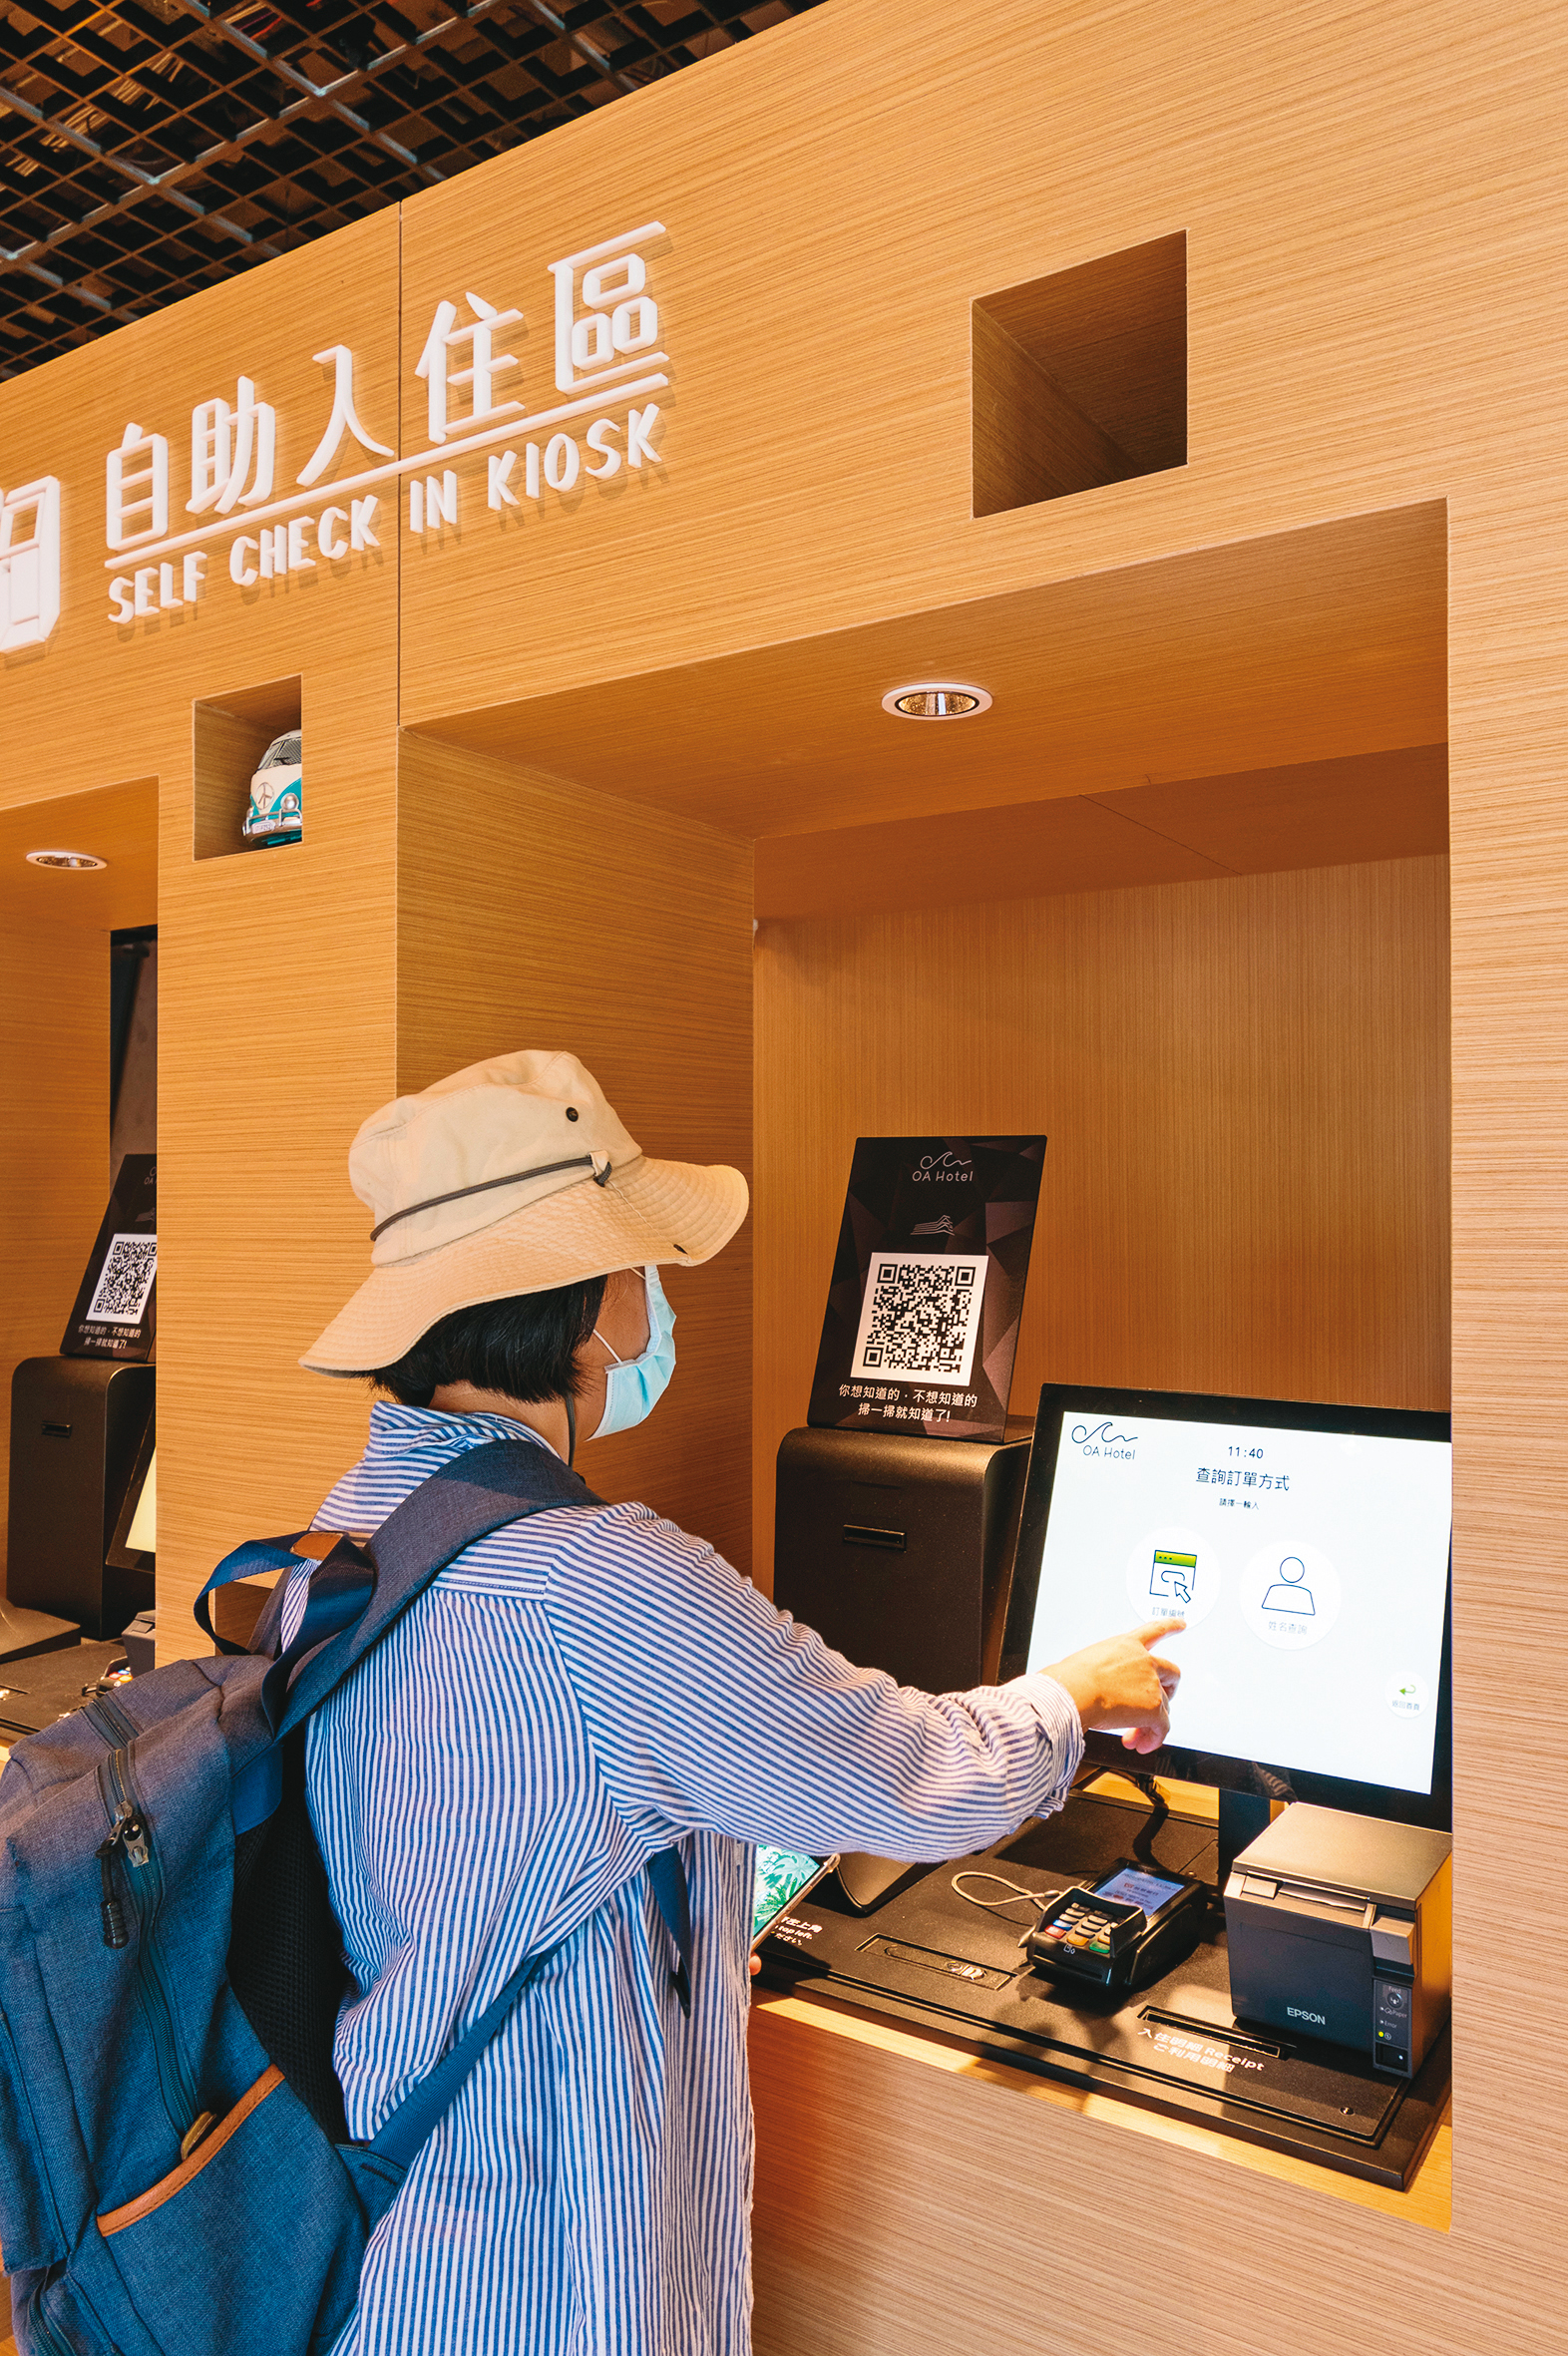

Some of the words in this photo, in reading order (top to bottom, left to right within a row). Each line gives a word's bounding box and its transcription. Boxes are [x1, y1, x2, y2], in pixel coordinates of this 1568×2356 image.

[106, 220, 670, 552] 自助入住區
[108, 551, 207, 625] SELF
[229, 494, 382, 587] CHECK
[409, 469, 458, 534] IN
[487, 402, 663, 511] KIOSK
[912, 1170, 932, 1182] OA
[935, 1170, 974, 1182] Hotel
[1082, 1444, 1100, 1457] OA
[1103, 1446, 1136, 1460] Hotel
[1228, 1445, 1264, 1459] 11:40
[1195, 1467, 1291, 1491] 查詢訂單方式
[1287, 2006, 1326, 2026] EPSON
[1203, 2046, 1266, 2072] Receipt
